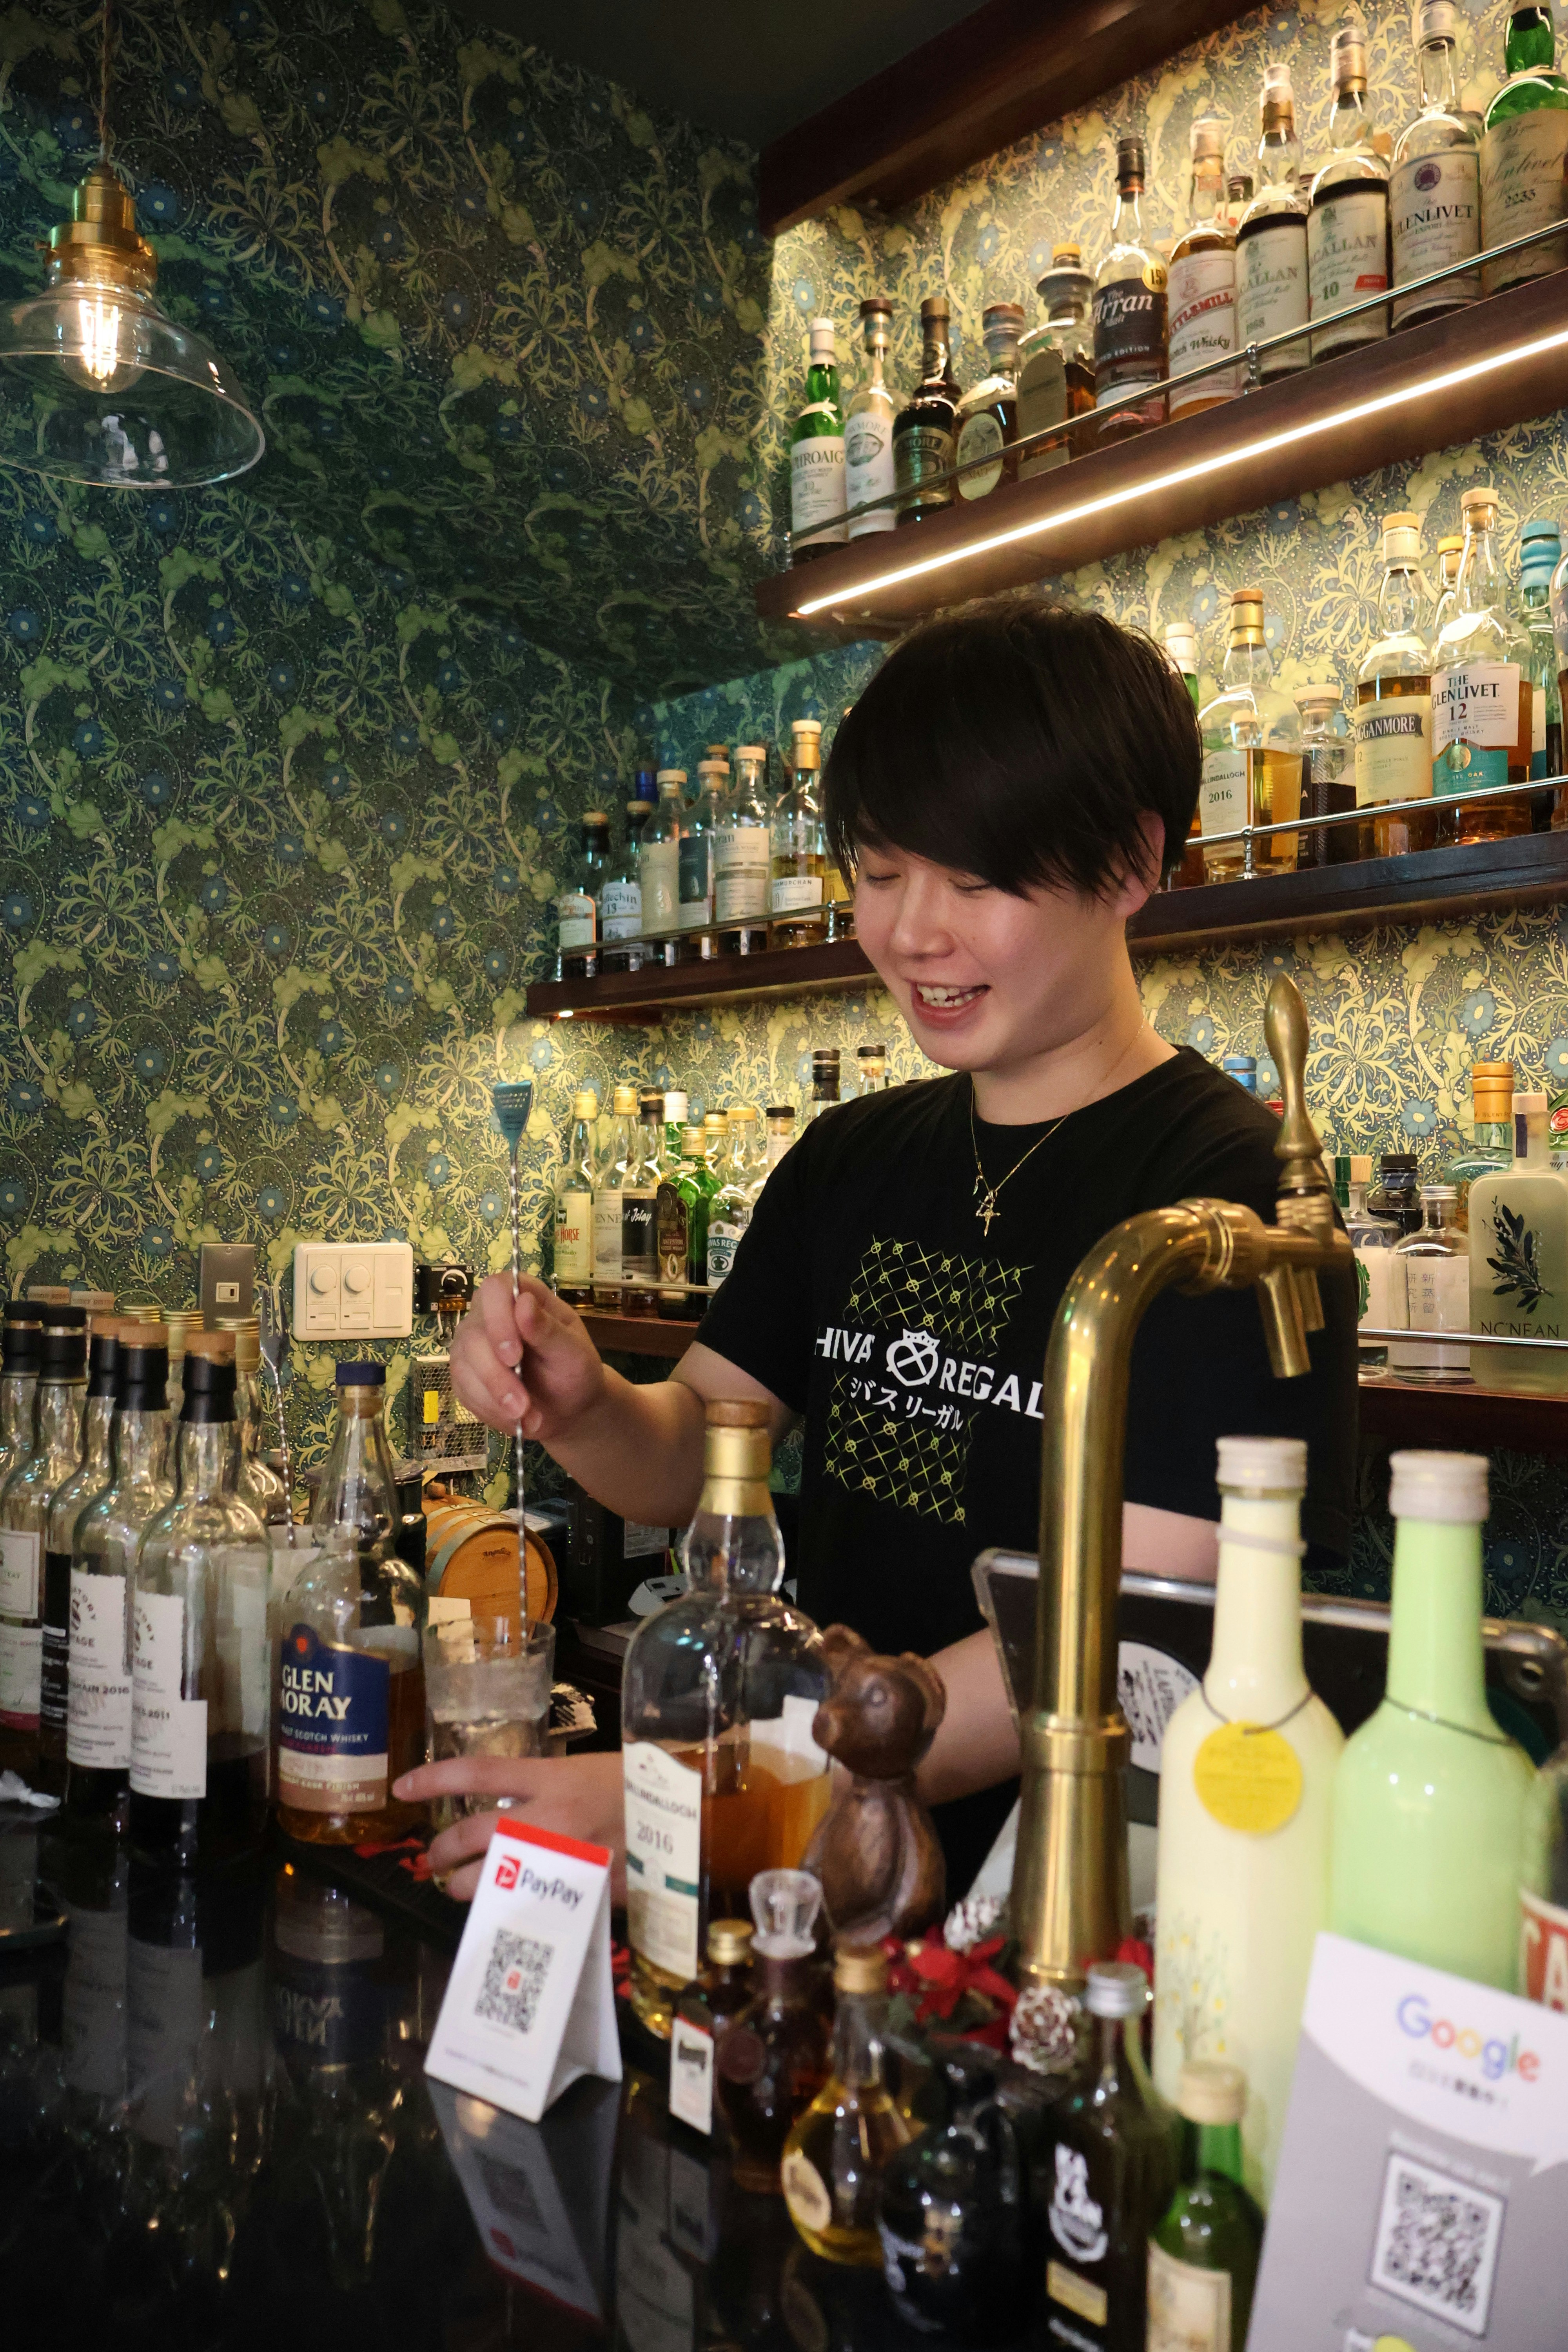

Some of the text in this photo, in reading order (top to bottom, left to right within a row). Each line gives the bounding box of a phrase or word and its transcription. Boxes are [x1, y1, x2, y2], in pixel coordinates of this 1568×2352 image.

[1447, 675, 1469, 688] THE
[1450, 702, 1468, 721] 12
[1209, 789, 1232, 804] 2016
[939, 1358, 1044, 1419] REGAL
[282, 1664, 333, 1694] GLEN
[521, 1867, 584, 1911] PayPay
[1397, 1993, 1540, 2083] Google
